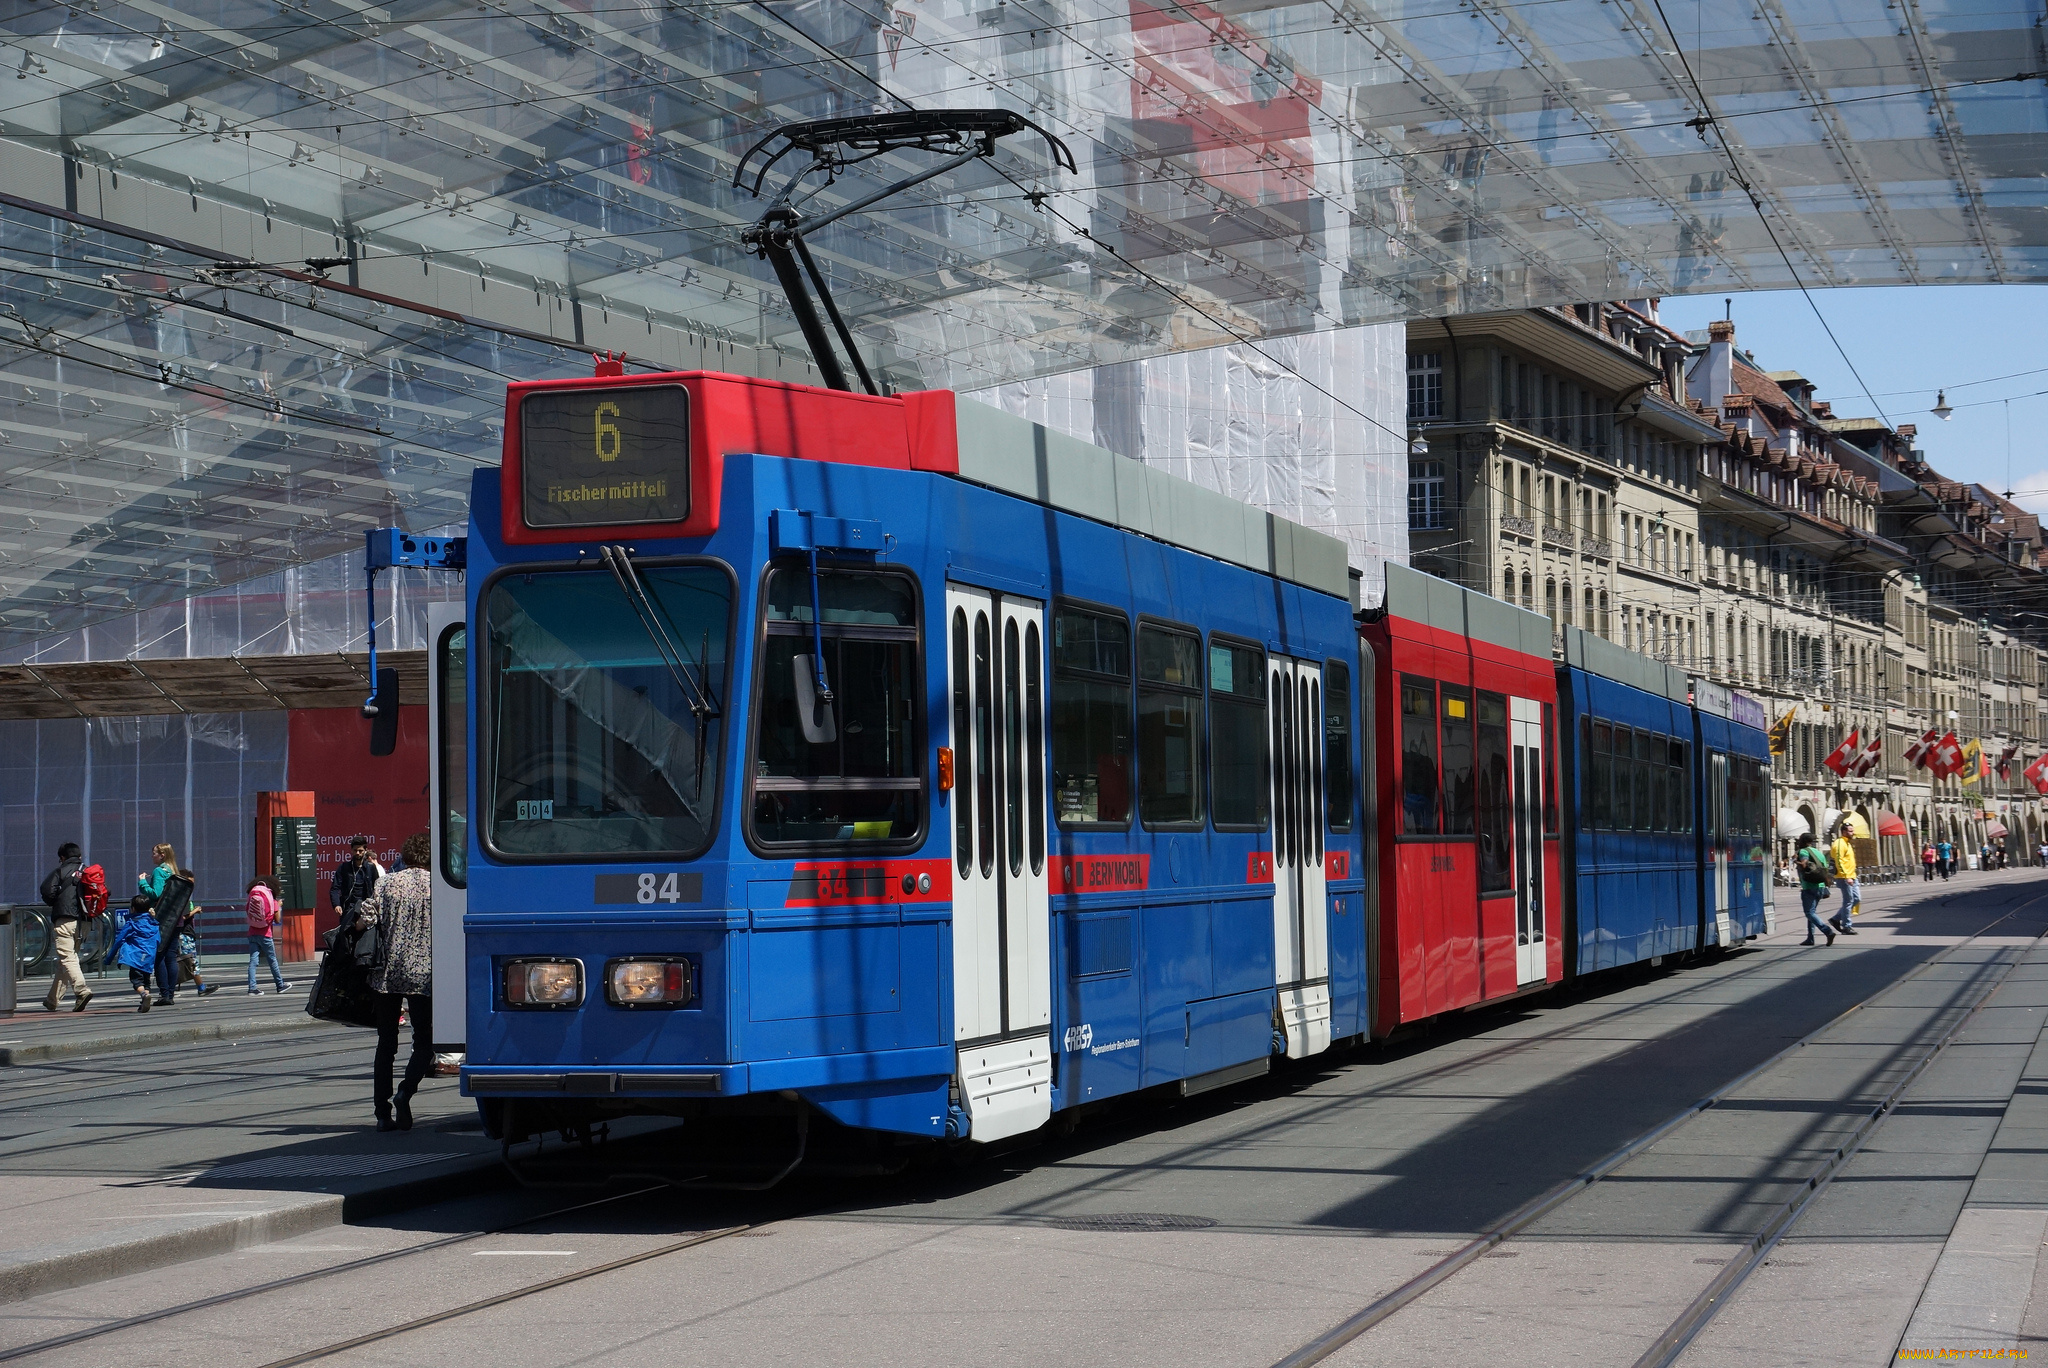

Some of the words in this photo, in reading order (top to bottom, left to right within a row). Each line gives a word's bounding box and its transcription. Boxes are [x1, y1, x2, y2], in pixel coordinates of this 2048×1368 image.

[595, 401, 621, 462] 6
[547, 480, 667, 503] Fischermätteli
[519, 804, 550, 816] 604
[316, 832, 376, 845] Renovaon
[380, 849, 401, 862] offe
[636, 872, 681, 904] 84
[817, 868, 849, 899] 84
[1069, 1024, 1087, 1052] RBS
